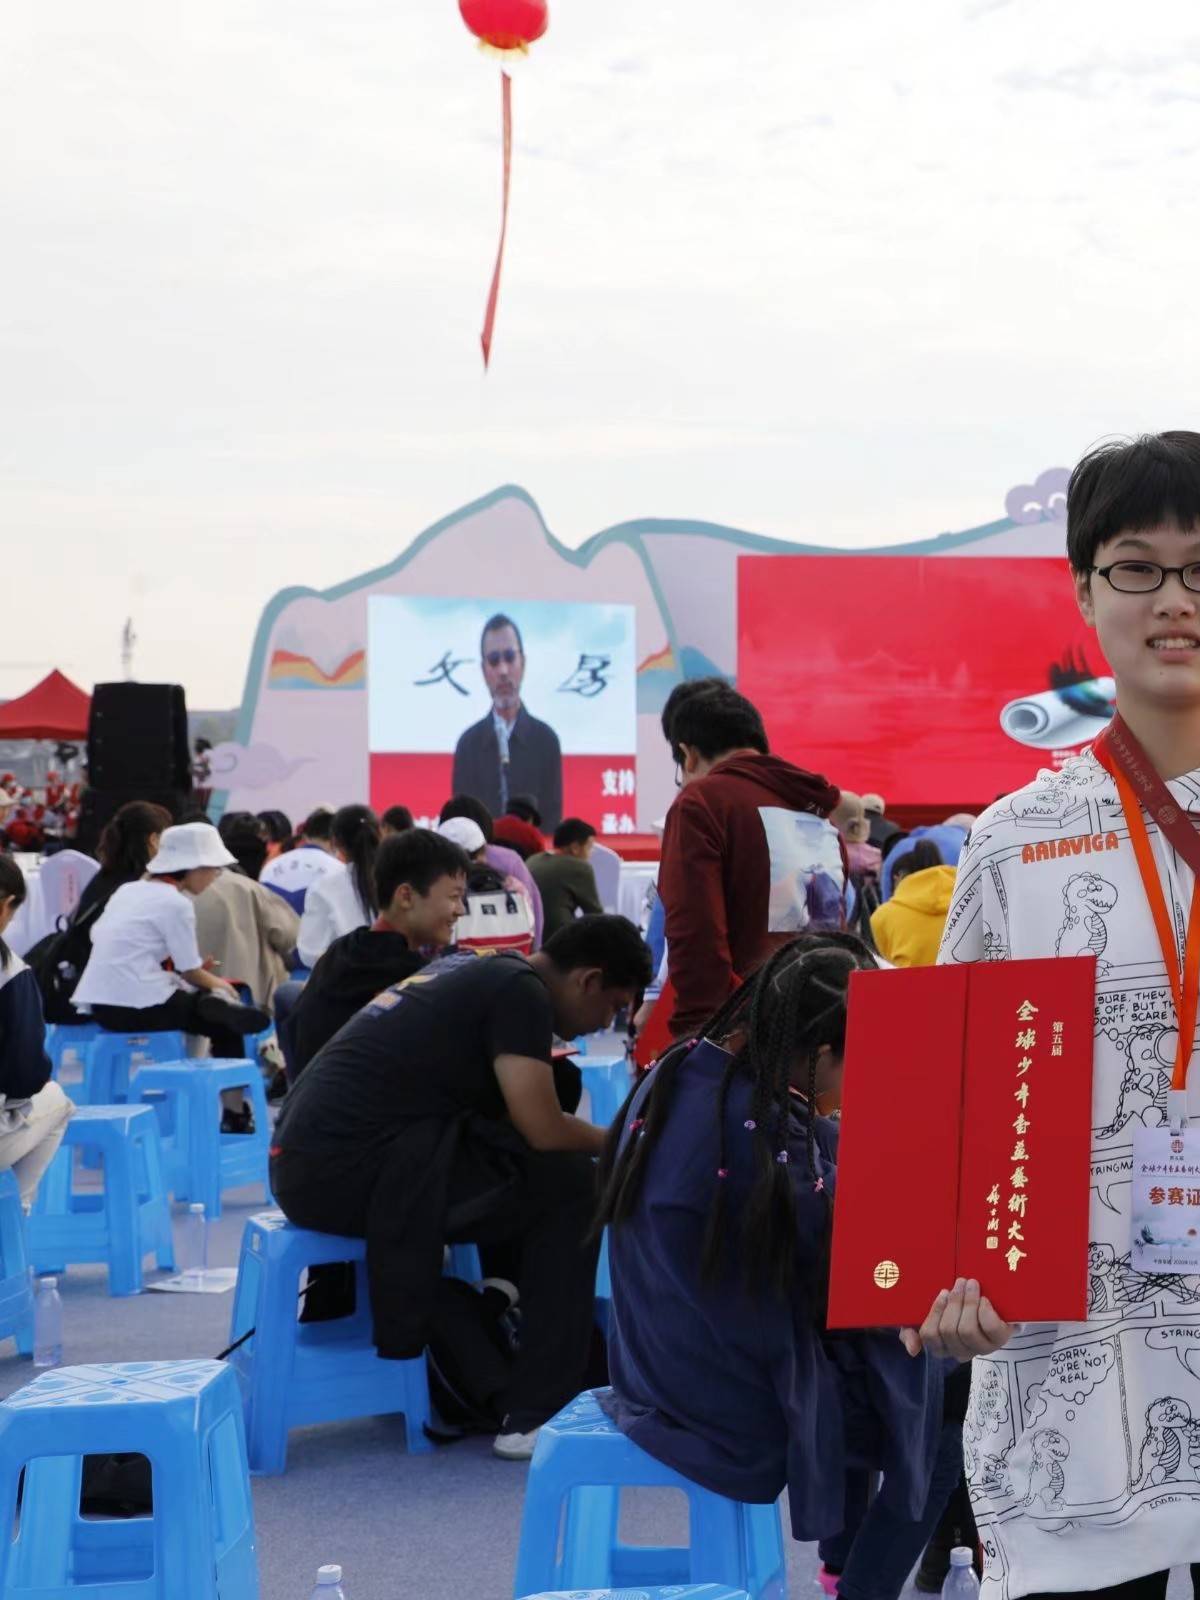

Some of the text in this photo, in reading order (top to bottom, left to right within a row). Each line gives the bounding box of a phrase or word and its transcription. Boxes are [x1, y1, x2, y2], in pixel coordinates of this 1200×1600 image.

[601, 768, 635, 796] 支持
[1135, 990, 1166, 1001] THEY
[1132, 1002, 1155, 1012] BUT
[1131, 1011, 1168, 1022] SCARE
[1051, 1020, 1064, 1056] 第五届
[1085, 1353, 1107, 1368] NOT
[1059, 1371, 1088, 1384] REAL
